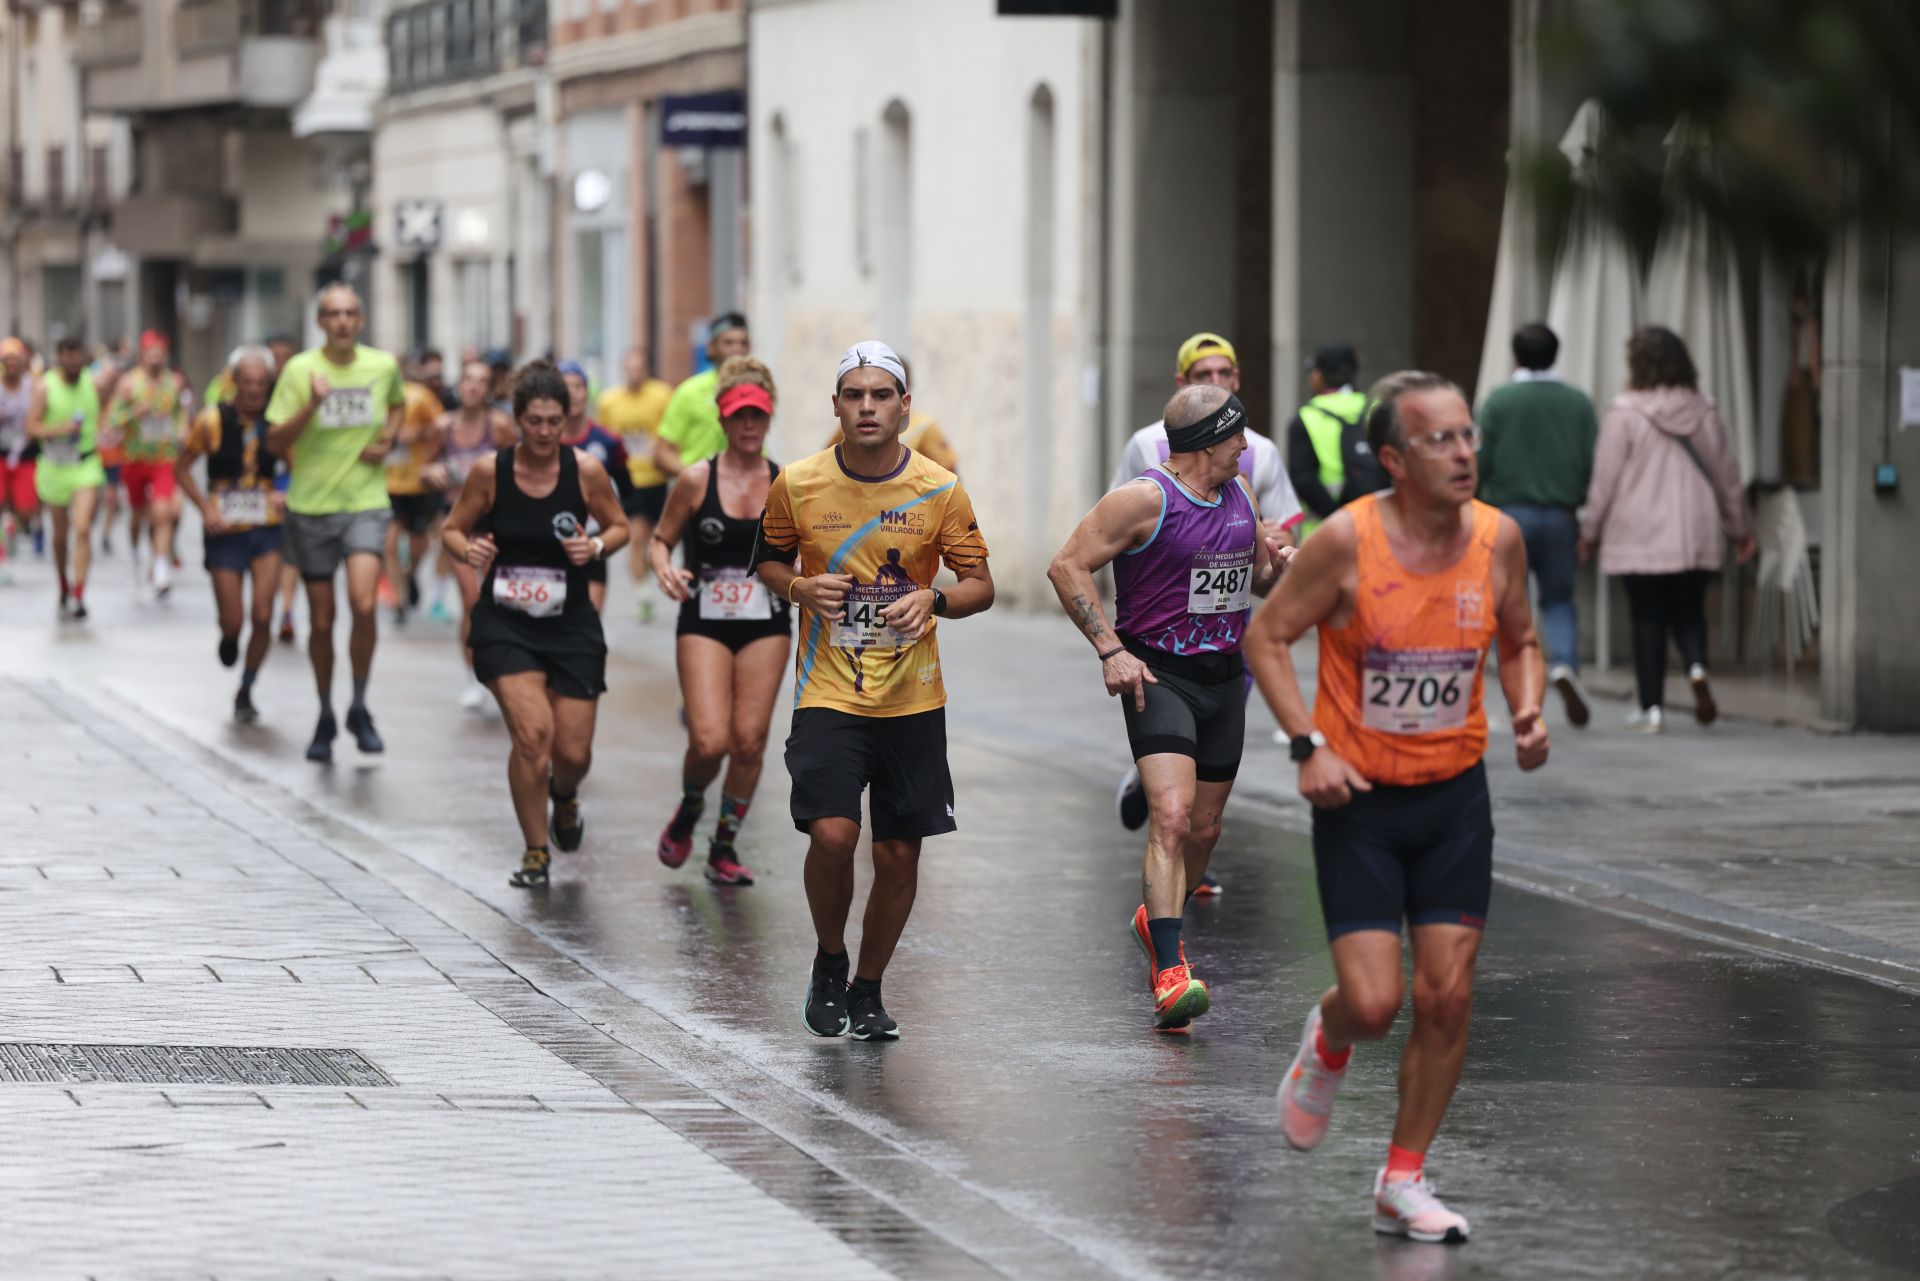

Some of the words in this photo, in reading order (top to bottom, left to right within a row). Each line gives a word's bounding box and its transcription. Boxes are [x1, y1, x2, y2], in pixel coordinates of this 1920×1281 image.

[880, 526, 924, 535] VALLADOLID
[505, 580, 548, 603] 556
[712, 582, 753, 604] 537
[1194, 567, 1249, 595] 2487
[838, 603, 888, 629] 145
[1370, 673, 1460, 707] 2706
